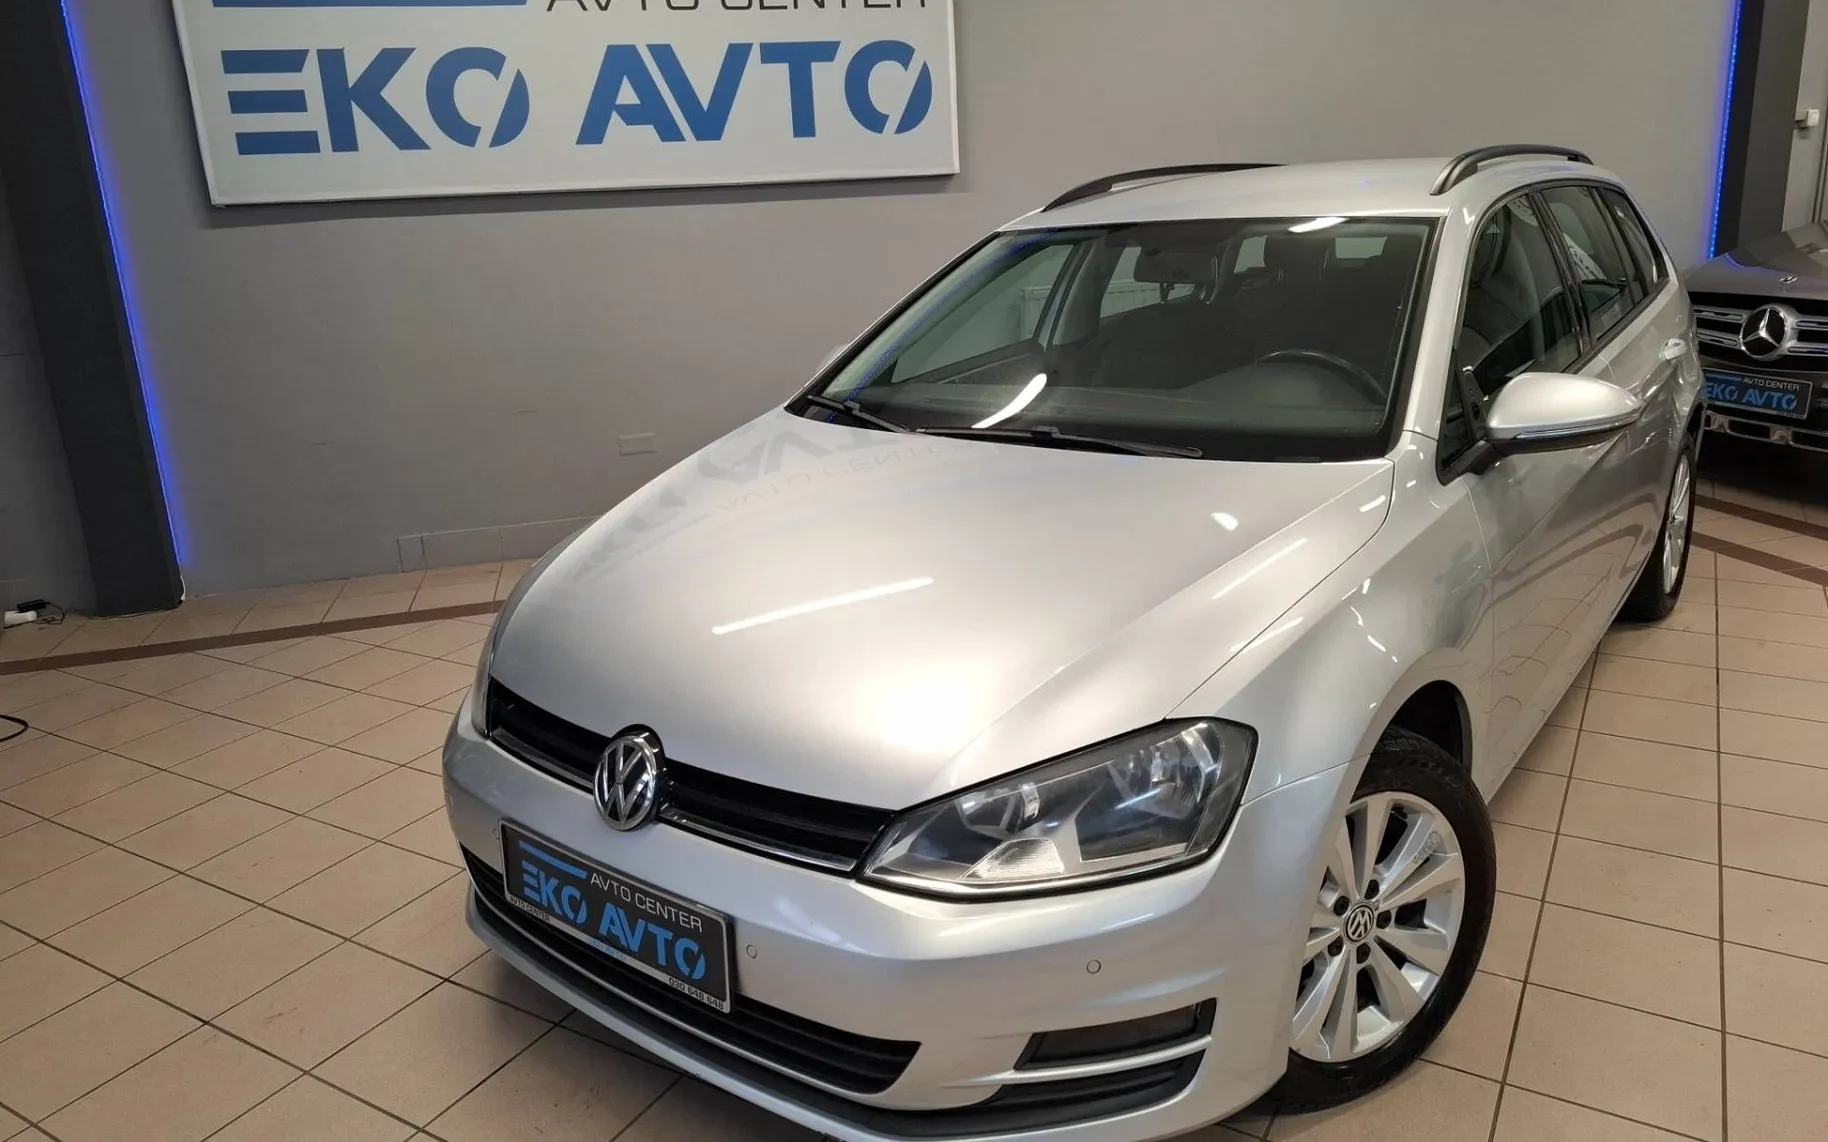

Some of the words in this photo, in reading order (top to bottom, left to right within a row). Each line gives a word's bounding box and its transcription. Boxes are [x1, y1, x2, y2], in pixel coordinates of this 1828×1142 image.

[221, 47, 530, 156] EKO
[576, 40, 933, 145] AVTO
[1742, 388, 1798, 410] AVTO
[1743, 377, 1766, 388] AVTO
[1766, 380, 1800, 392] CENTER
[522, 861, 588, 927] EKO
[598, 902, 707, 980] AVTO
[590, 872, 632, 903] AVTO
[635, 892, 704, 933] CENTER
